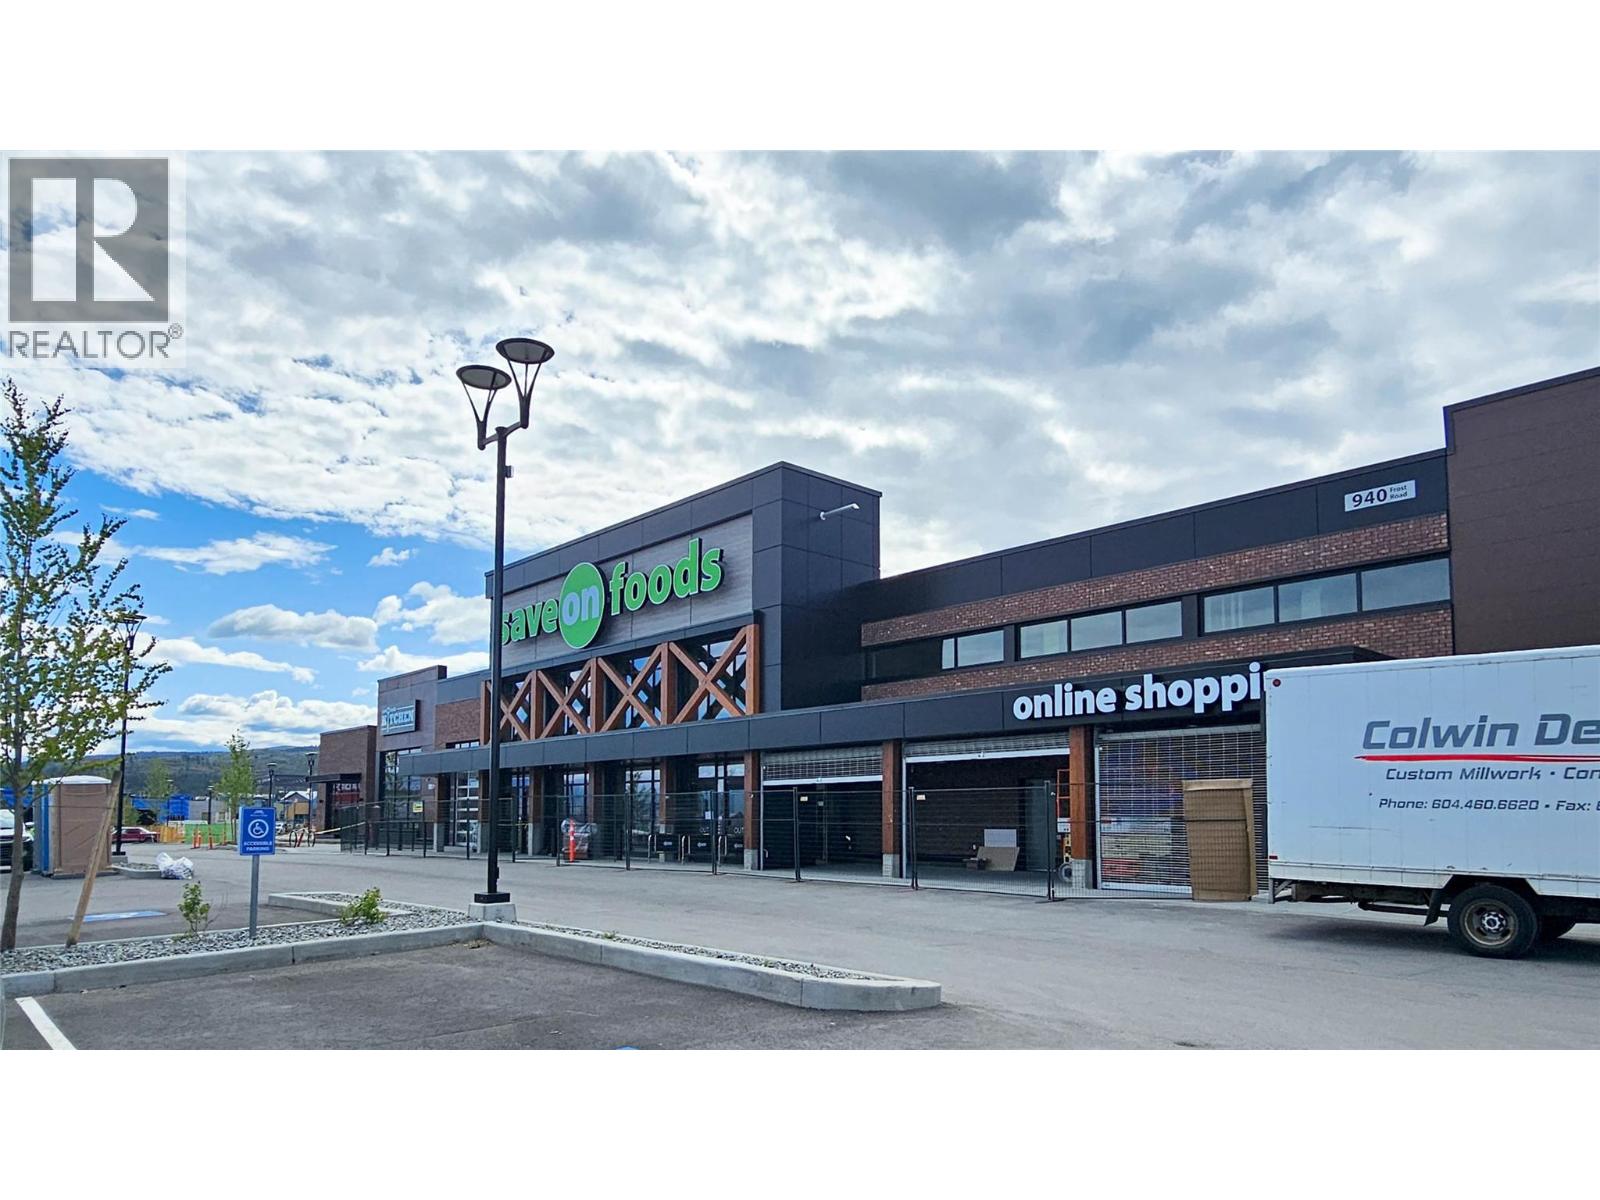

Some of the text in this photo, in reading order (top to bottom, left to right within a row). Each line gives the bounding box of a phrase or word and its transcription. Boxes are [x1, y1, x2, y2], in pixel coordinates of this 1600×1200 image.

[1389, 485, 1407, 493] Frost
[1389, 491, 1408, 500] Road
[1352, 488, 1388, 508] 940
[562, 584, 600, 626] on
[609, 537, 723, 617] foods
[1012, 682, 1117, 721] online
[1362, 713, 1600, 750] Colwin De
[1385, 768, 1453, 780] Custom
[1459, 767, 1541, 780] Millwork
[1378, 798, 1428, 809] Phone:
[1431, 799, 1539, 810] 604.460.6620
[1555, 800, 1592, 811] Fax:
